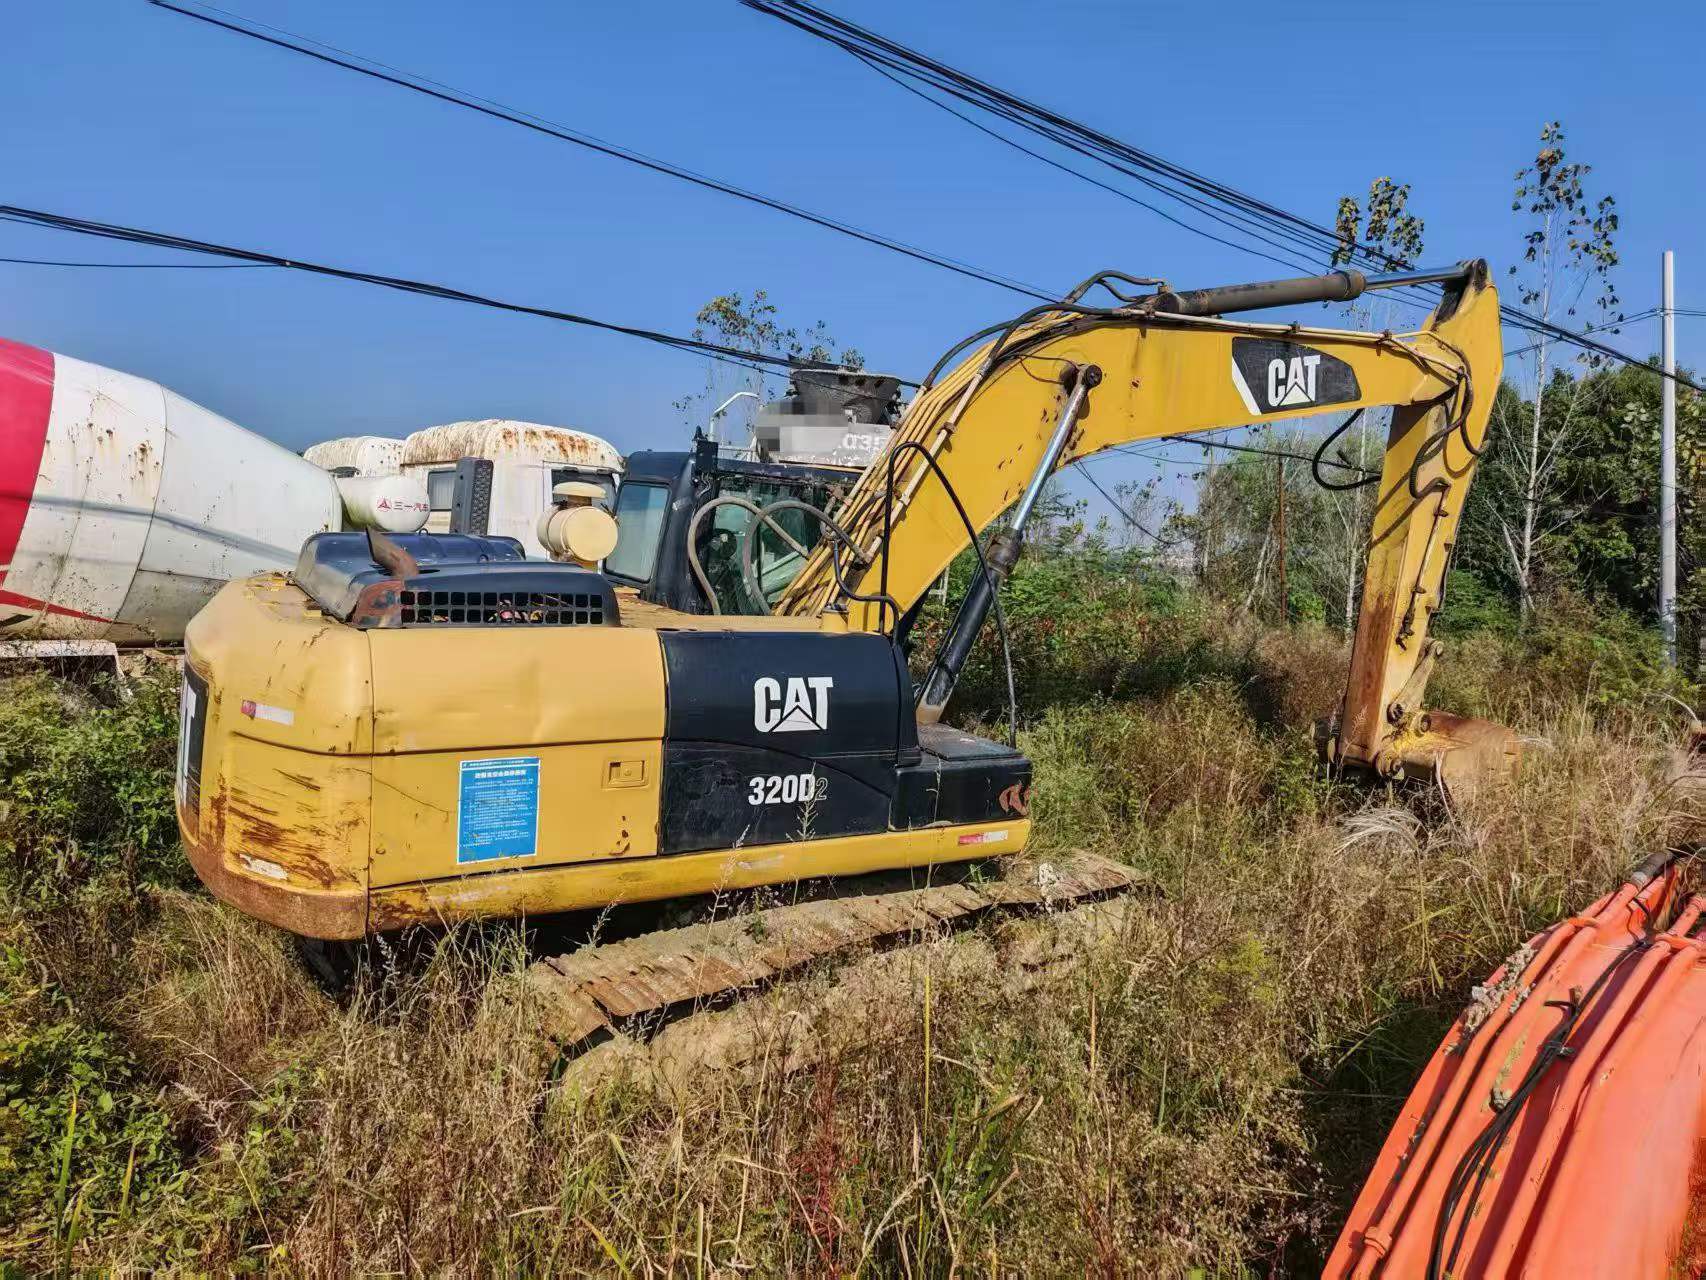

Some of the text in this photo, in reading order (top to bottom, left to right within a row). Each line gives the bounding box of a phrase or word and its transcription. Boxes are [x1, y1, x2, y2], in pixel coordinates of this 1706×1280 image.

[1268, 355, 1321, 407] CAT
[393, 501, 429, 512] 三一汽车
[754, 676, 834, 733] CAT
[748, 773, 828, 806] 320D2
